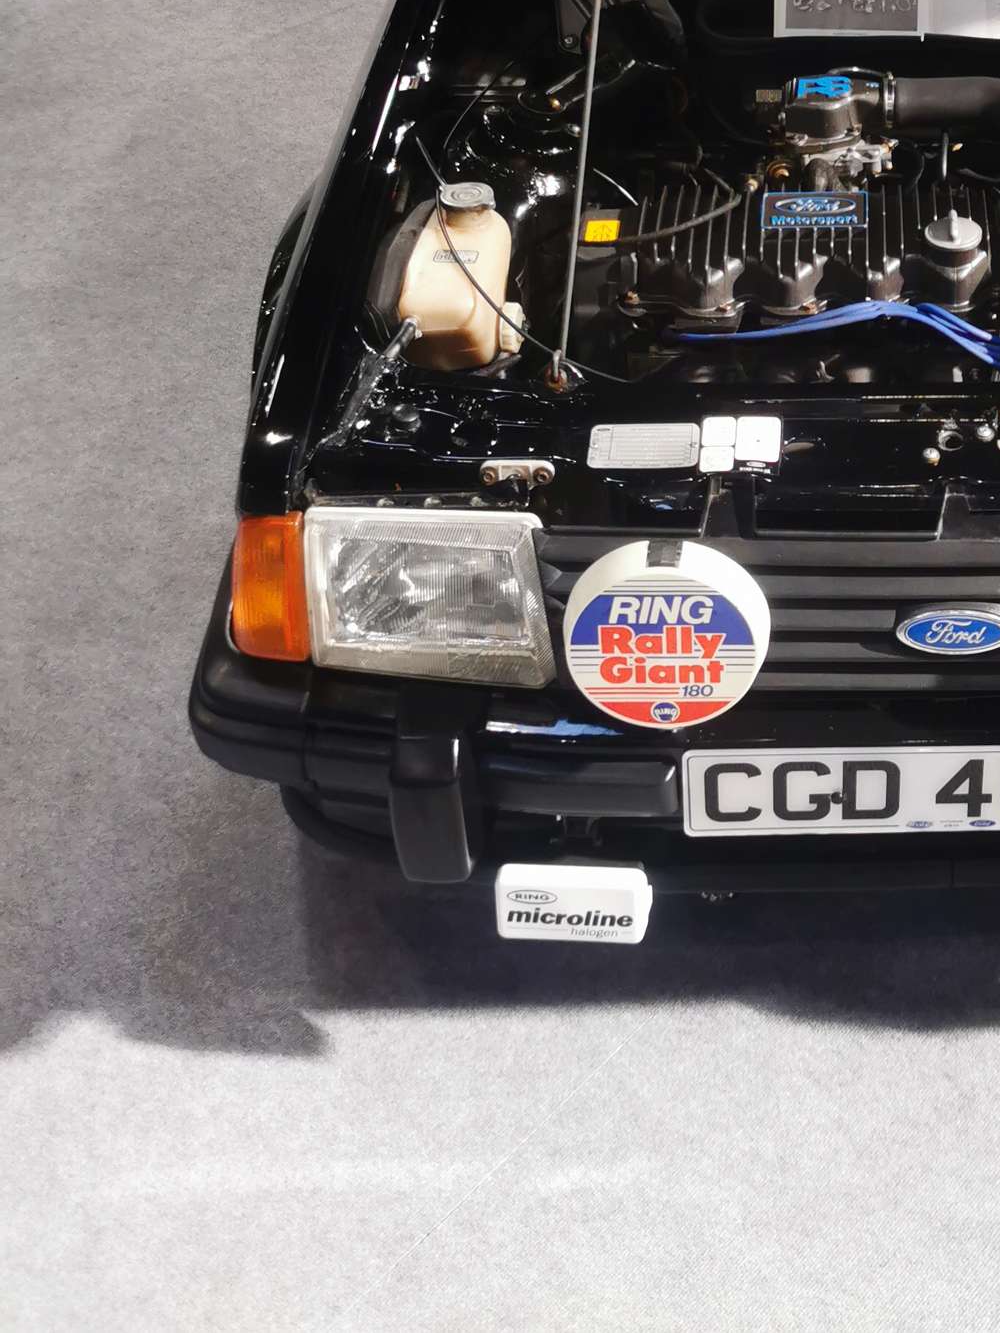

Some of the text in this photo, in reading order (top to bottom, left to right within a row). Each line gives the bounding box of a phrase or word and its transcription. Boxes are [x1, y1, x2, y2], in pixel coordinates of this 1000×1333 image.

[771, 215, 858, 226] Motorsport
[608, 596, 714, 625] RING
[598, 624, 725, 660] Rally
[925, 619, 988, 647] Ford
[599, 656, 725, 685] Giant
[681, 684, 714, 698] 180
[654, 707, 677, 717] RING
[703, 759, 901, 823] CGD
[513, 891, 552, 902] RING
[506, 906, 634, 929] microline
[569, 925, 620, 939] halogen
